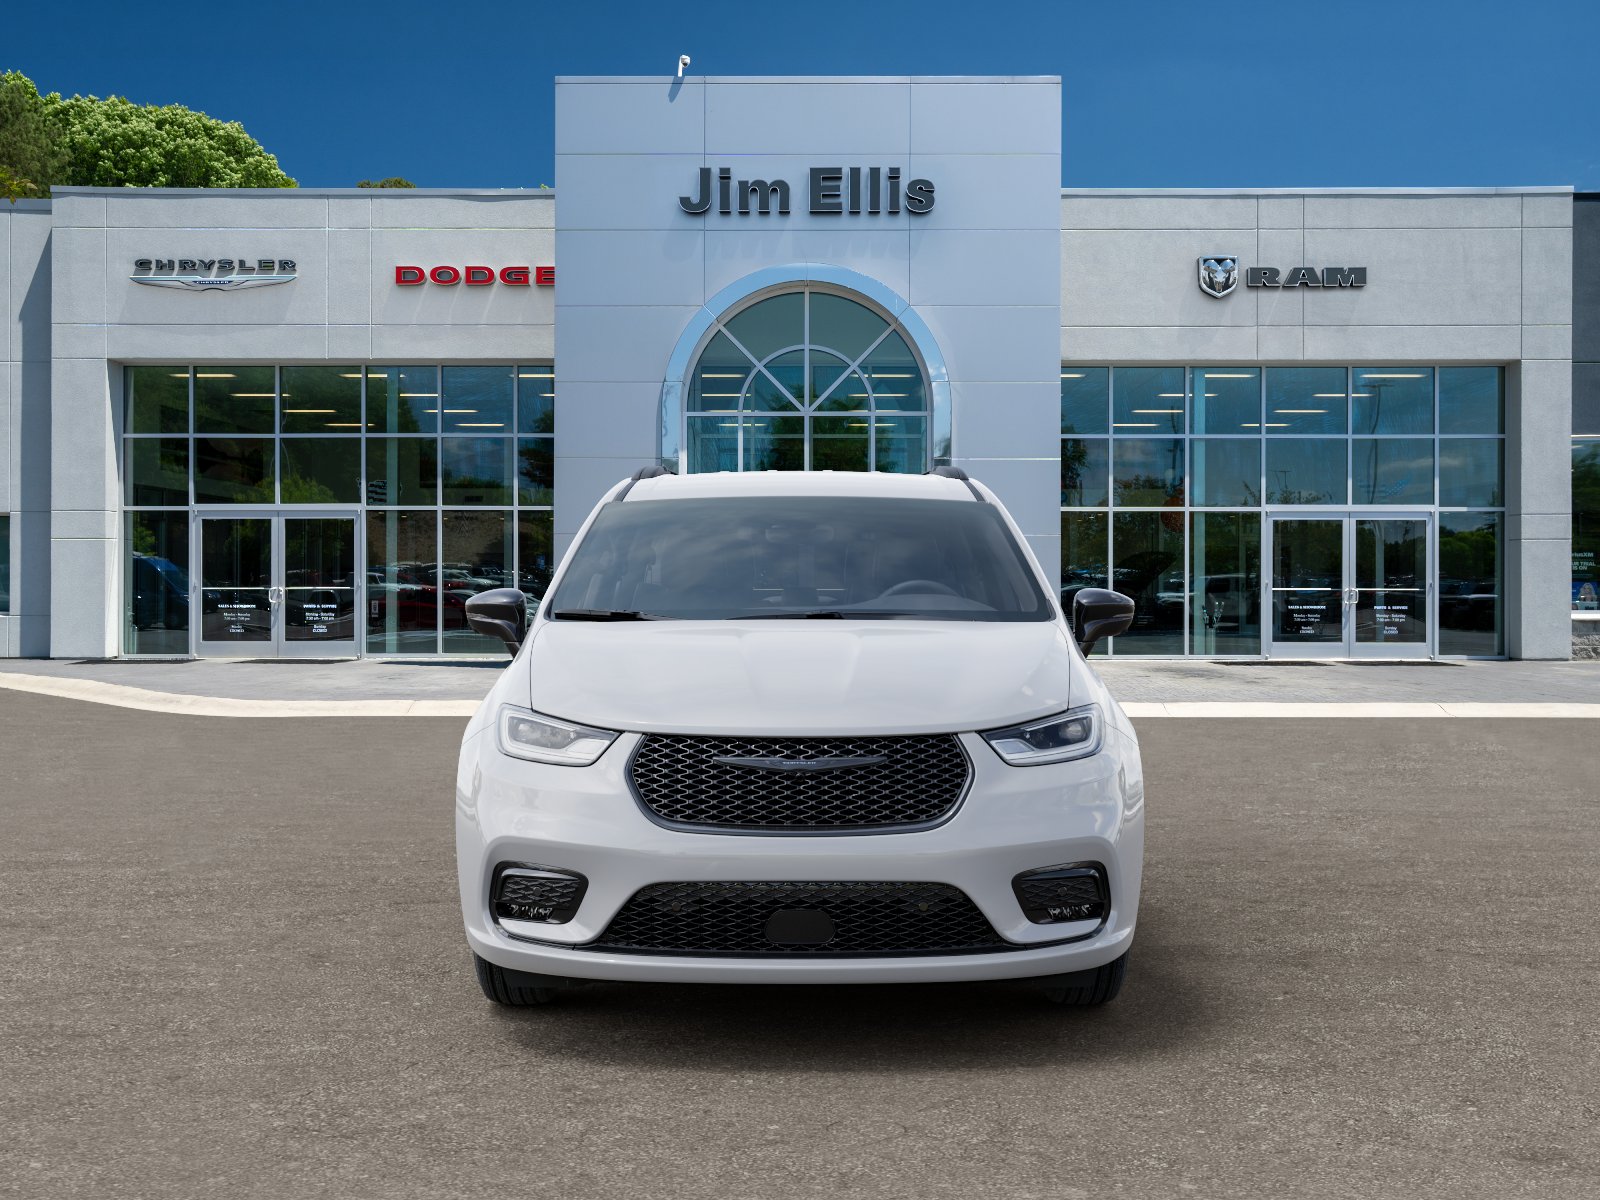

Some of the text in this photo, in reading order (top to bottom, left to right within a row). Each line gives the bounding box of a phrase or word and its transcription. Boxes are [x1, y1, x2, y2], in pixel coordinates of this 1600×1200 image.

[679, 167, 936, 213] Jim Ellis
[134, 258, 297, 271] CHRYSLER
[395, 266, 555, 286] DODGE
[1247, 267, 1367, 287] RAM
